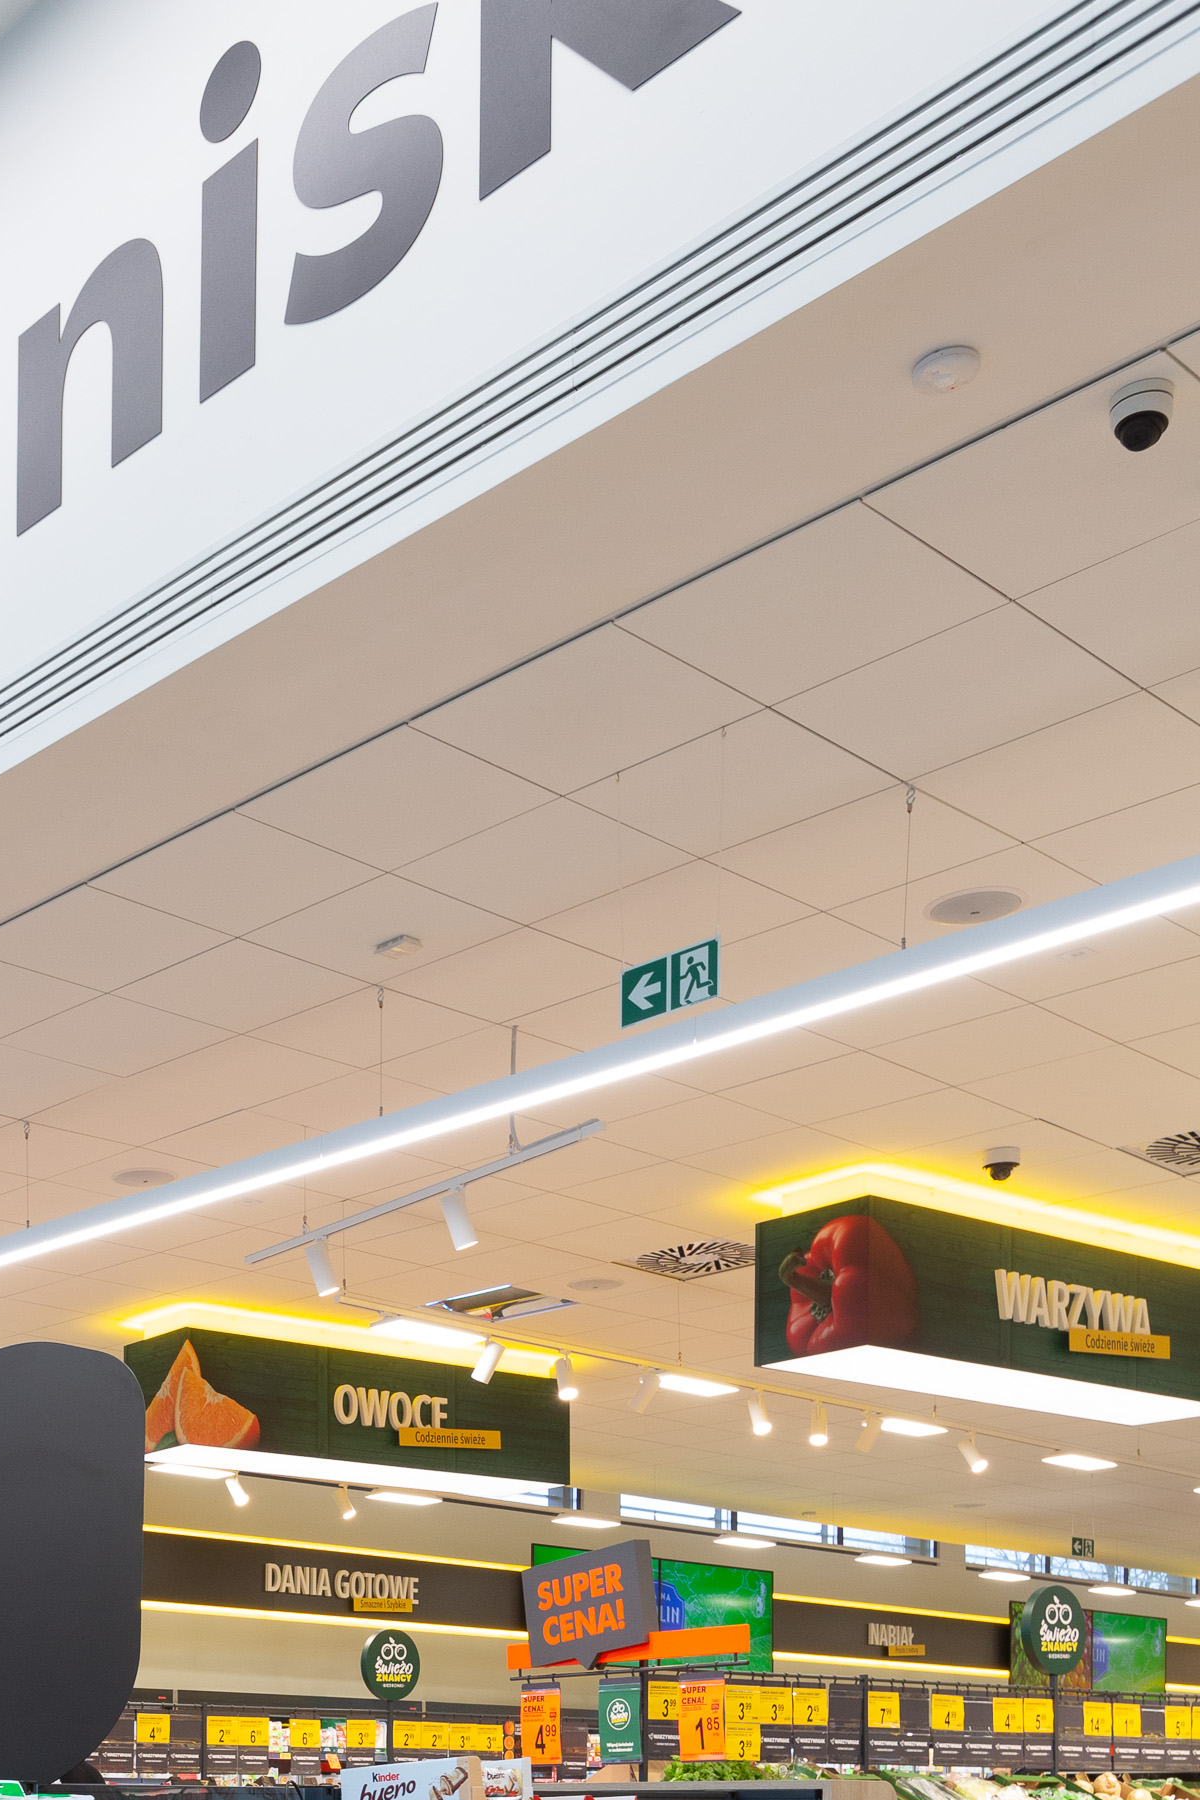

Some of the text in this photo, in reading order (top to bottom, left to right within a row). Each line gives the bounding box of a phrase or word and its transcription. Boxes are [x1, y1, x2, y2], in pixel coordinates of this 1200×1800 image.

[994, 1268, 1151, 1336] WARZYWA
[1085, 1333, 1155, 1354] Codziennie świeże
[333, 1383, 448, 1431] OWOCE
[414, 1430, 486, 1447] Codziennie świeże
[264, 1562, 419, 1605] DANIA GOTOWE
[536, 1563, 624, 1611] SUPER
[360, 1599, 383, 1609] Smaczne
[387, 1600, 407, 1611] Szybkie
[542, 1598, 626, 1646] CENA!
[868, 1622, 915, 1647] NABIAŁ
[523, 1695, 545, 1703] SUPER
[681, 1685, 707, 1694] SUPER
[522, 1705, 544, 1713] CENA!
[681, 1696, 705, 1705] CENA!
[372, 1771, 400, 1784] Kinder
